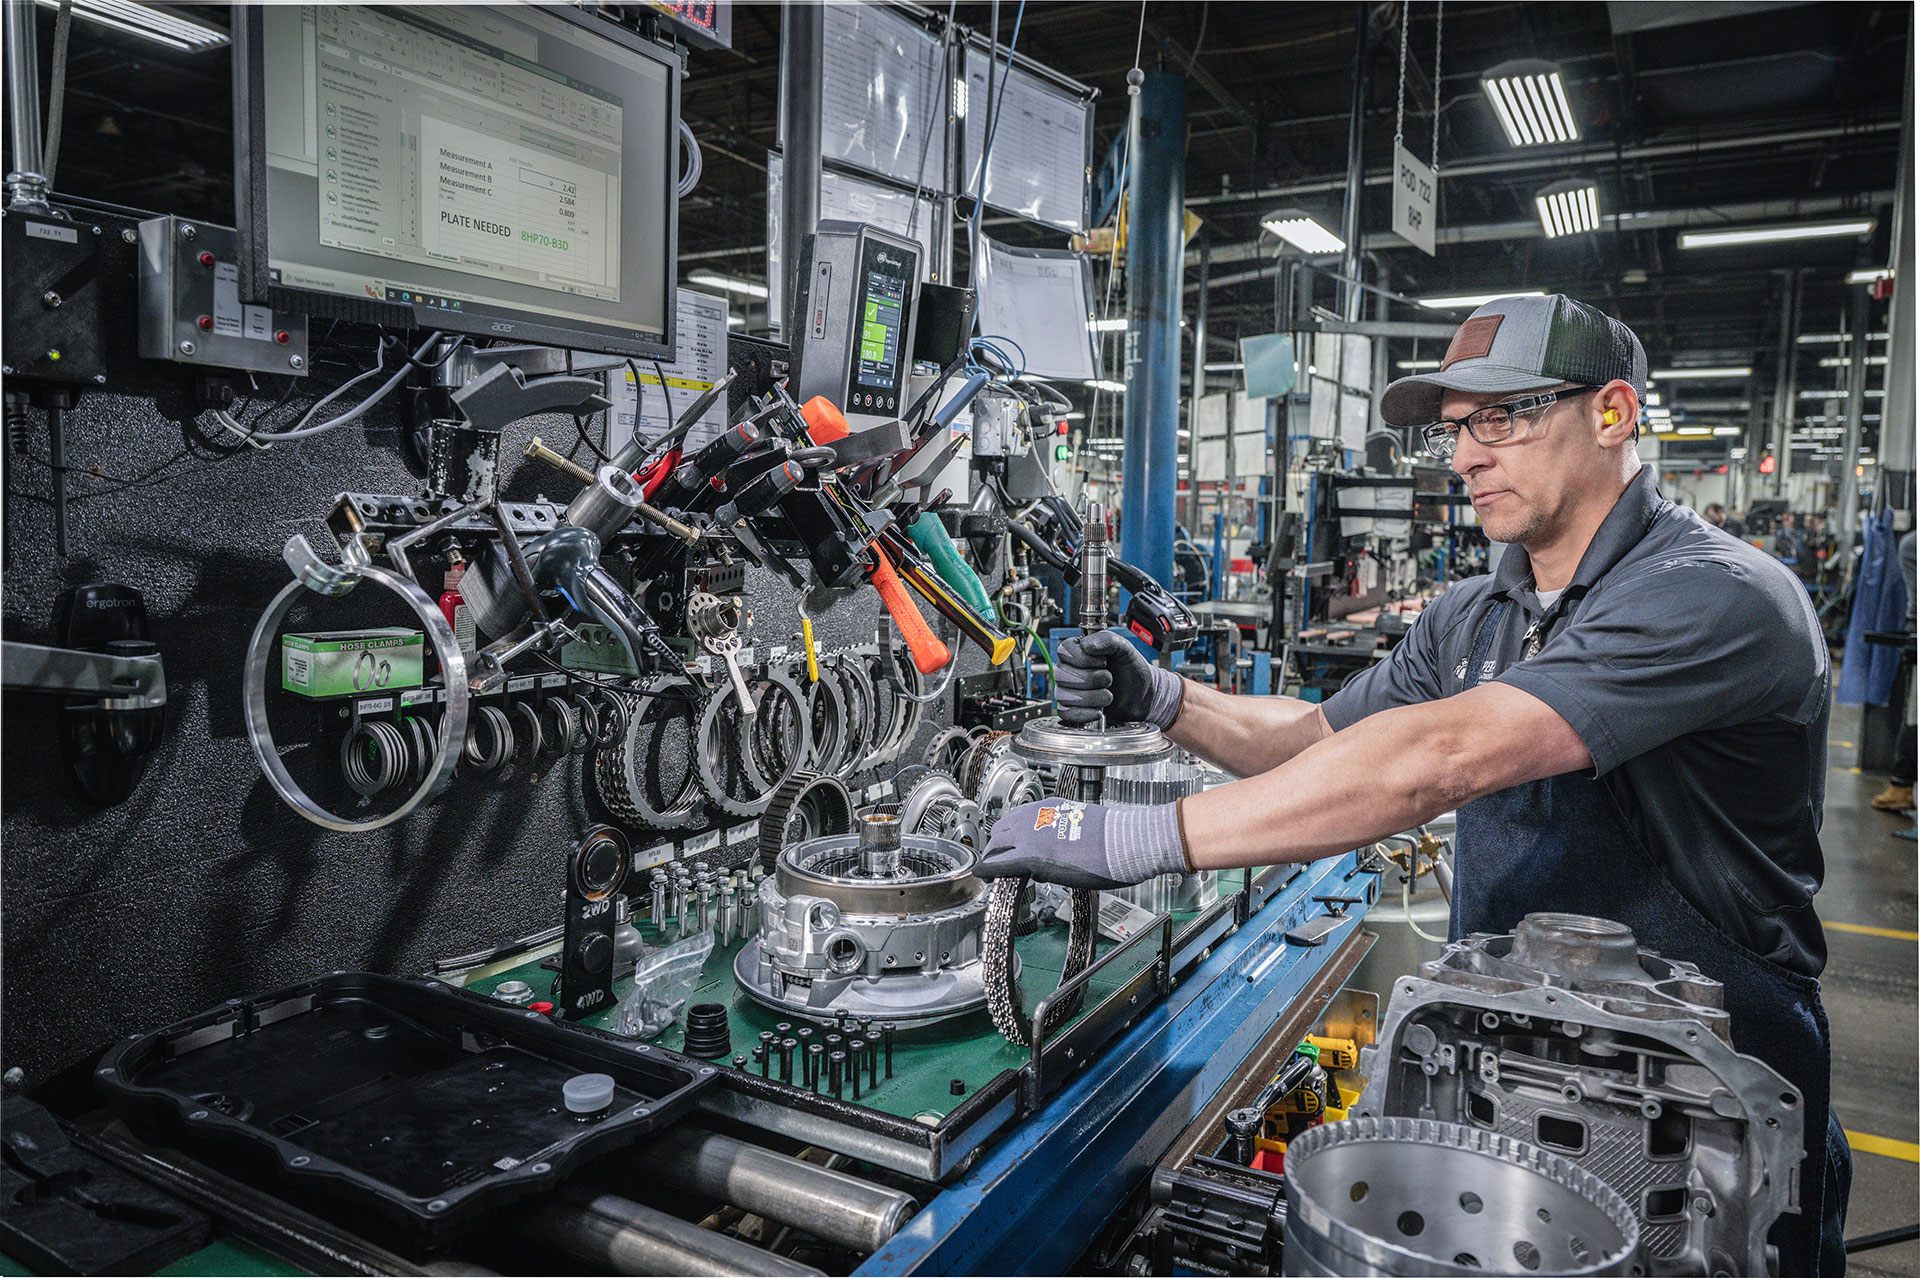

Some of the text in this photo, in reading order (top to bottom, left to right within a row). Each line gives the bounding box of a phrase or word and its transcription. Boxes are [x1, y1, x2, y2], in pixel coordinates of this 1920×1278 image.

[321, 61, 377, 86] Document Recovery
[440, 148, 493, 170] Measurement A
[440, 162, 492, 183] Measurement B
[440, 176, 492, 197] Measurement C
[562, 184, 575, 194] 2.42
[1401, 164, 1431, 204] POD 722
[559, 196, 575, 206] 2.584
[558, 208, 575, 219] 0.809
[441, 211, 511, 237] PLATE NEEDED
[521, 230, 569, 251] 8HP70-B3D
[491, 322, 515, 333] acer
[86, 597, 136, 609] ergotron
[340, 639, 404, 651] HOSE CLAMPS
[582, 900, 610, 920] 2WD
[576, 989, 604, 1009] 4WD
